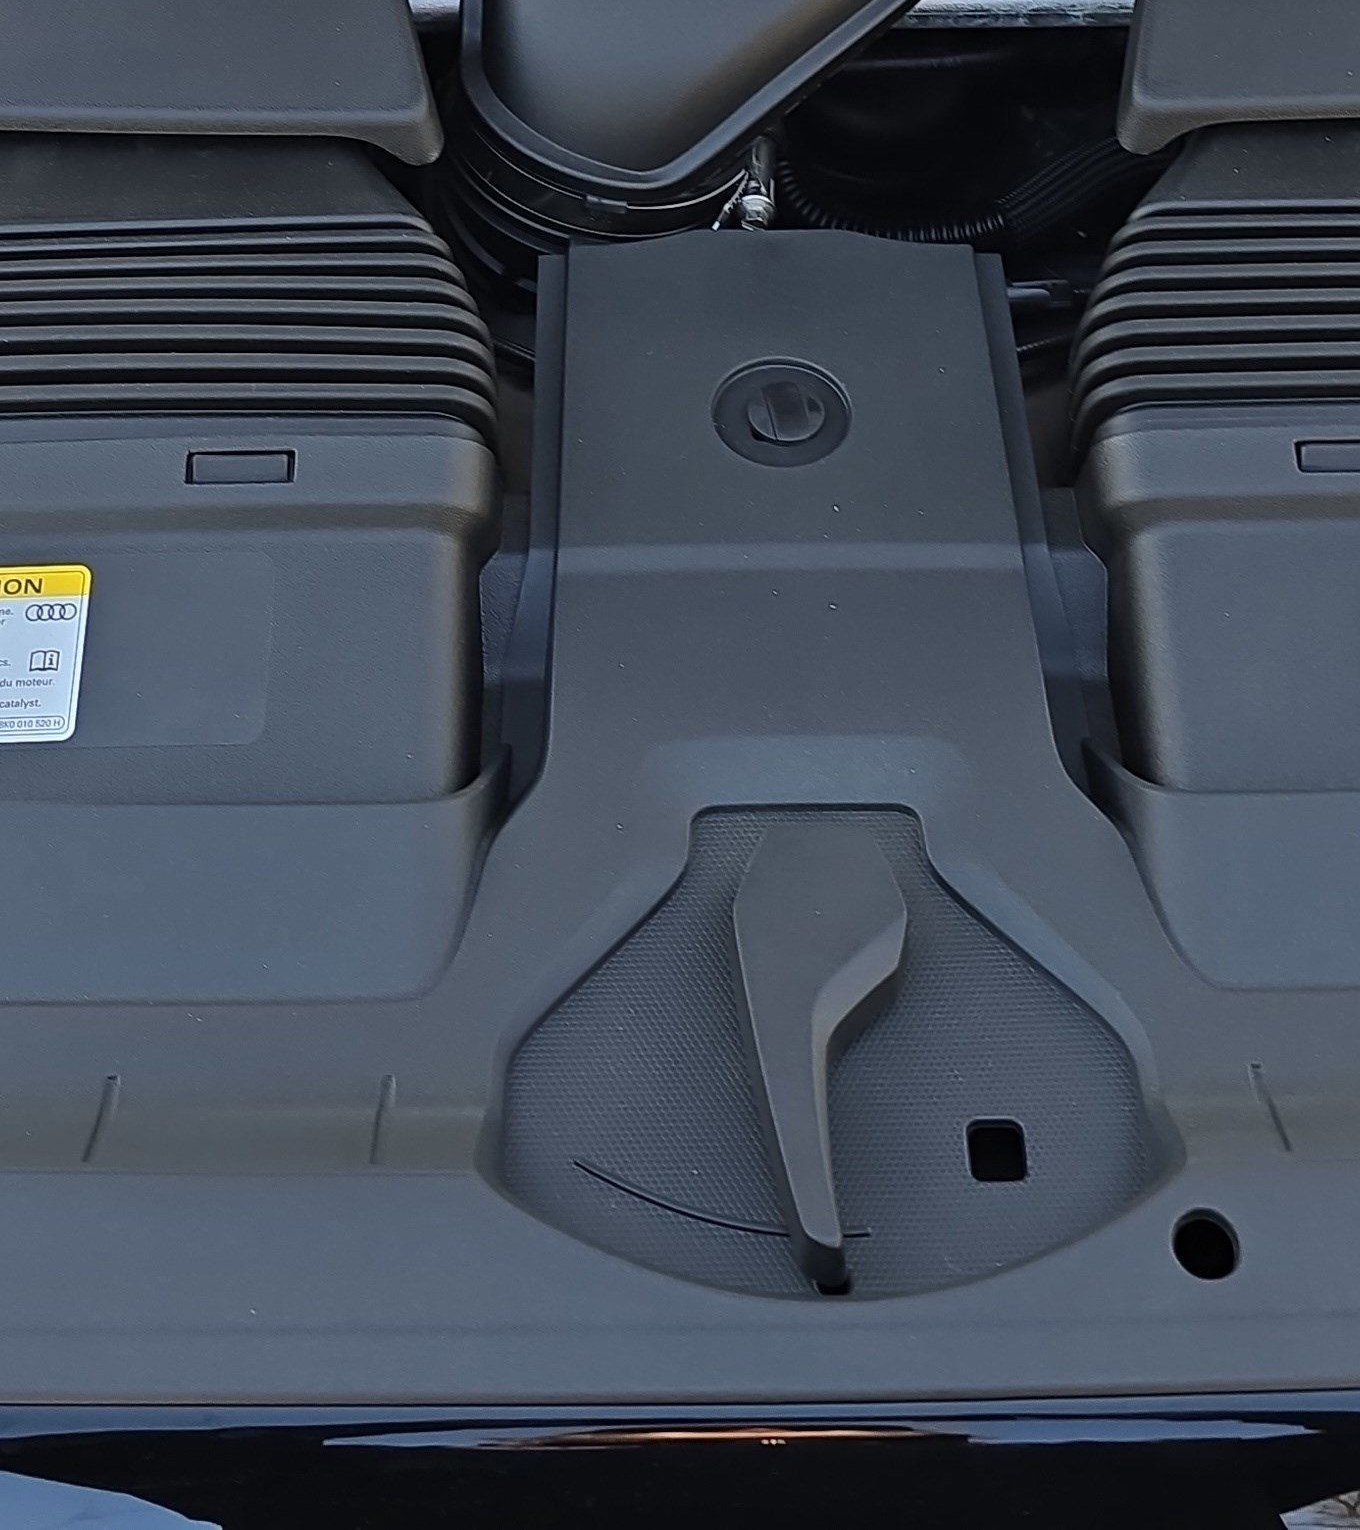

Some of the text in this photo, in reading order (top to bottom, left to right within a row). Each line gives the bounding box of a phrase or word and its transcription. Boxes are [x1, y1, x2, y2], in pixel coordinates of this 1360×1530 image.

[0, 678, 13, 688] du
[15, 677, 55, 687] moteur.
[16, 719, 34, 729] 010
[35, 719, 52, 728] 520
[53, 718, 61, 727] H
